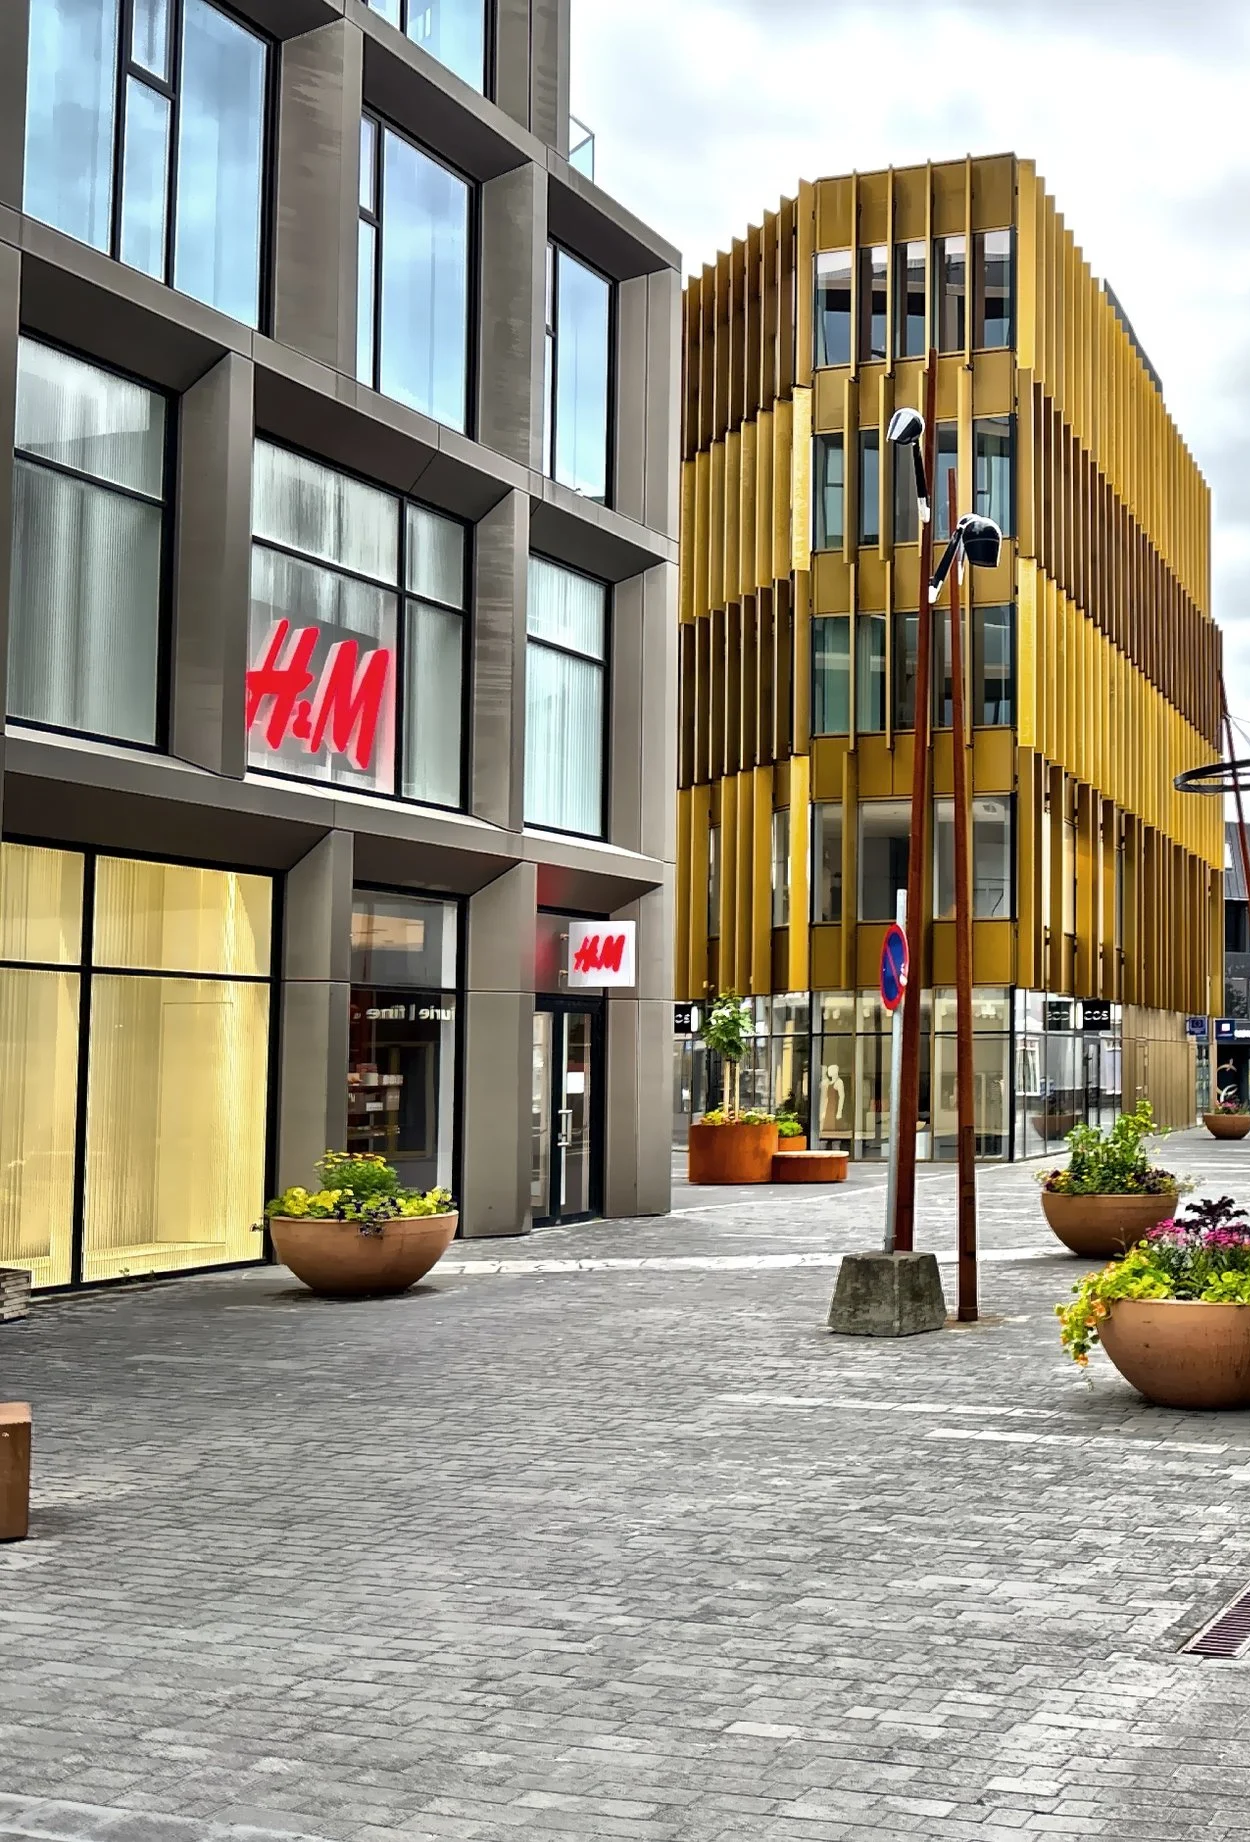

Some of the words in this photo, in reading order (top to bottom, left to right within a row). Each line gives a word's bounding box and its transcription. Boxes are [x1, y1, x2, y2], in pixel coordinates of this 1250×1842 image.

[246, 619, 389, 770] H&M
[574, 935, 626, 972] H&M
[1083, 1009, 1109, 1021] COS
